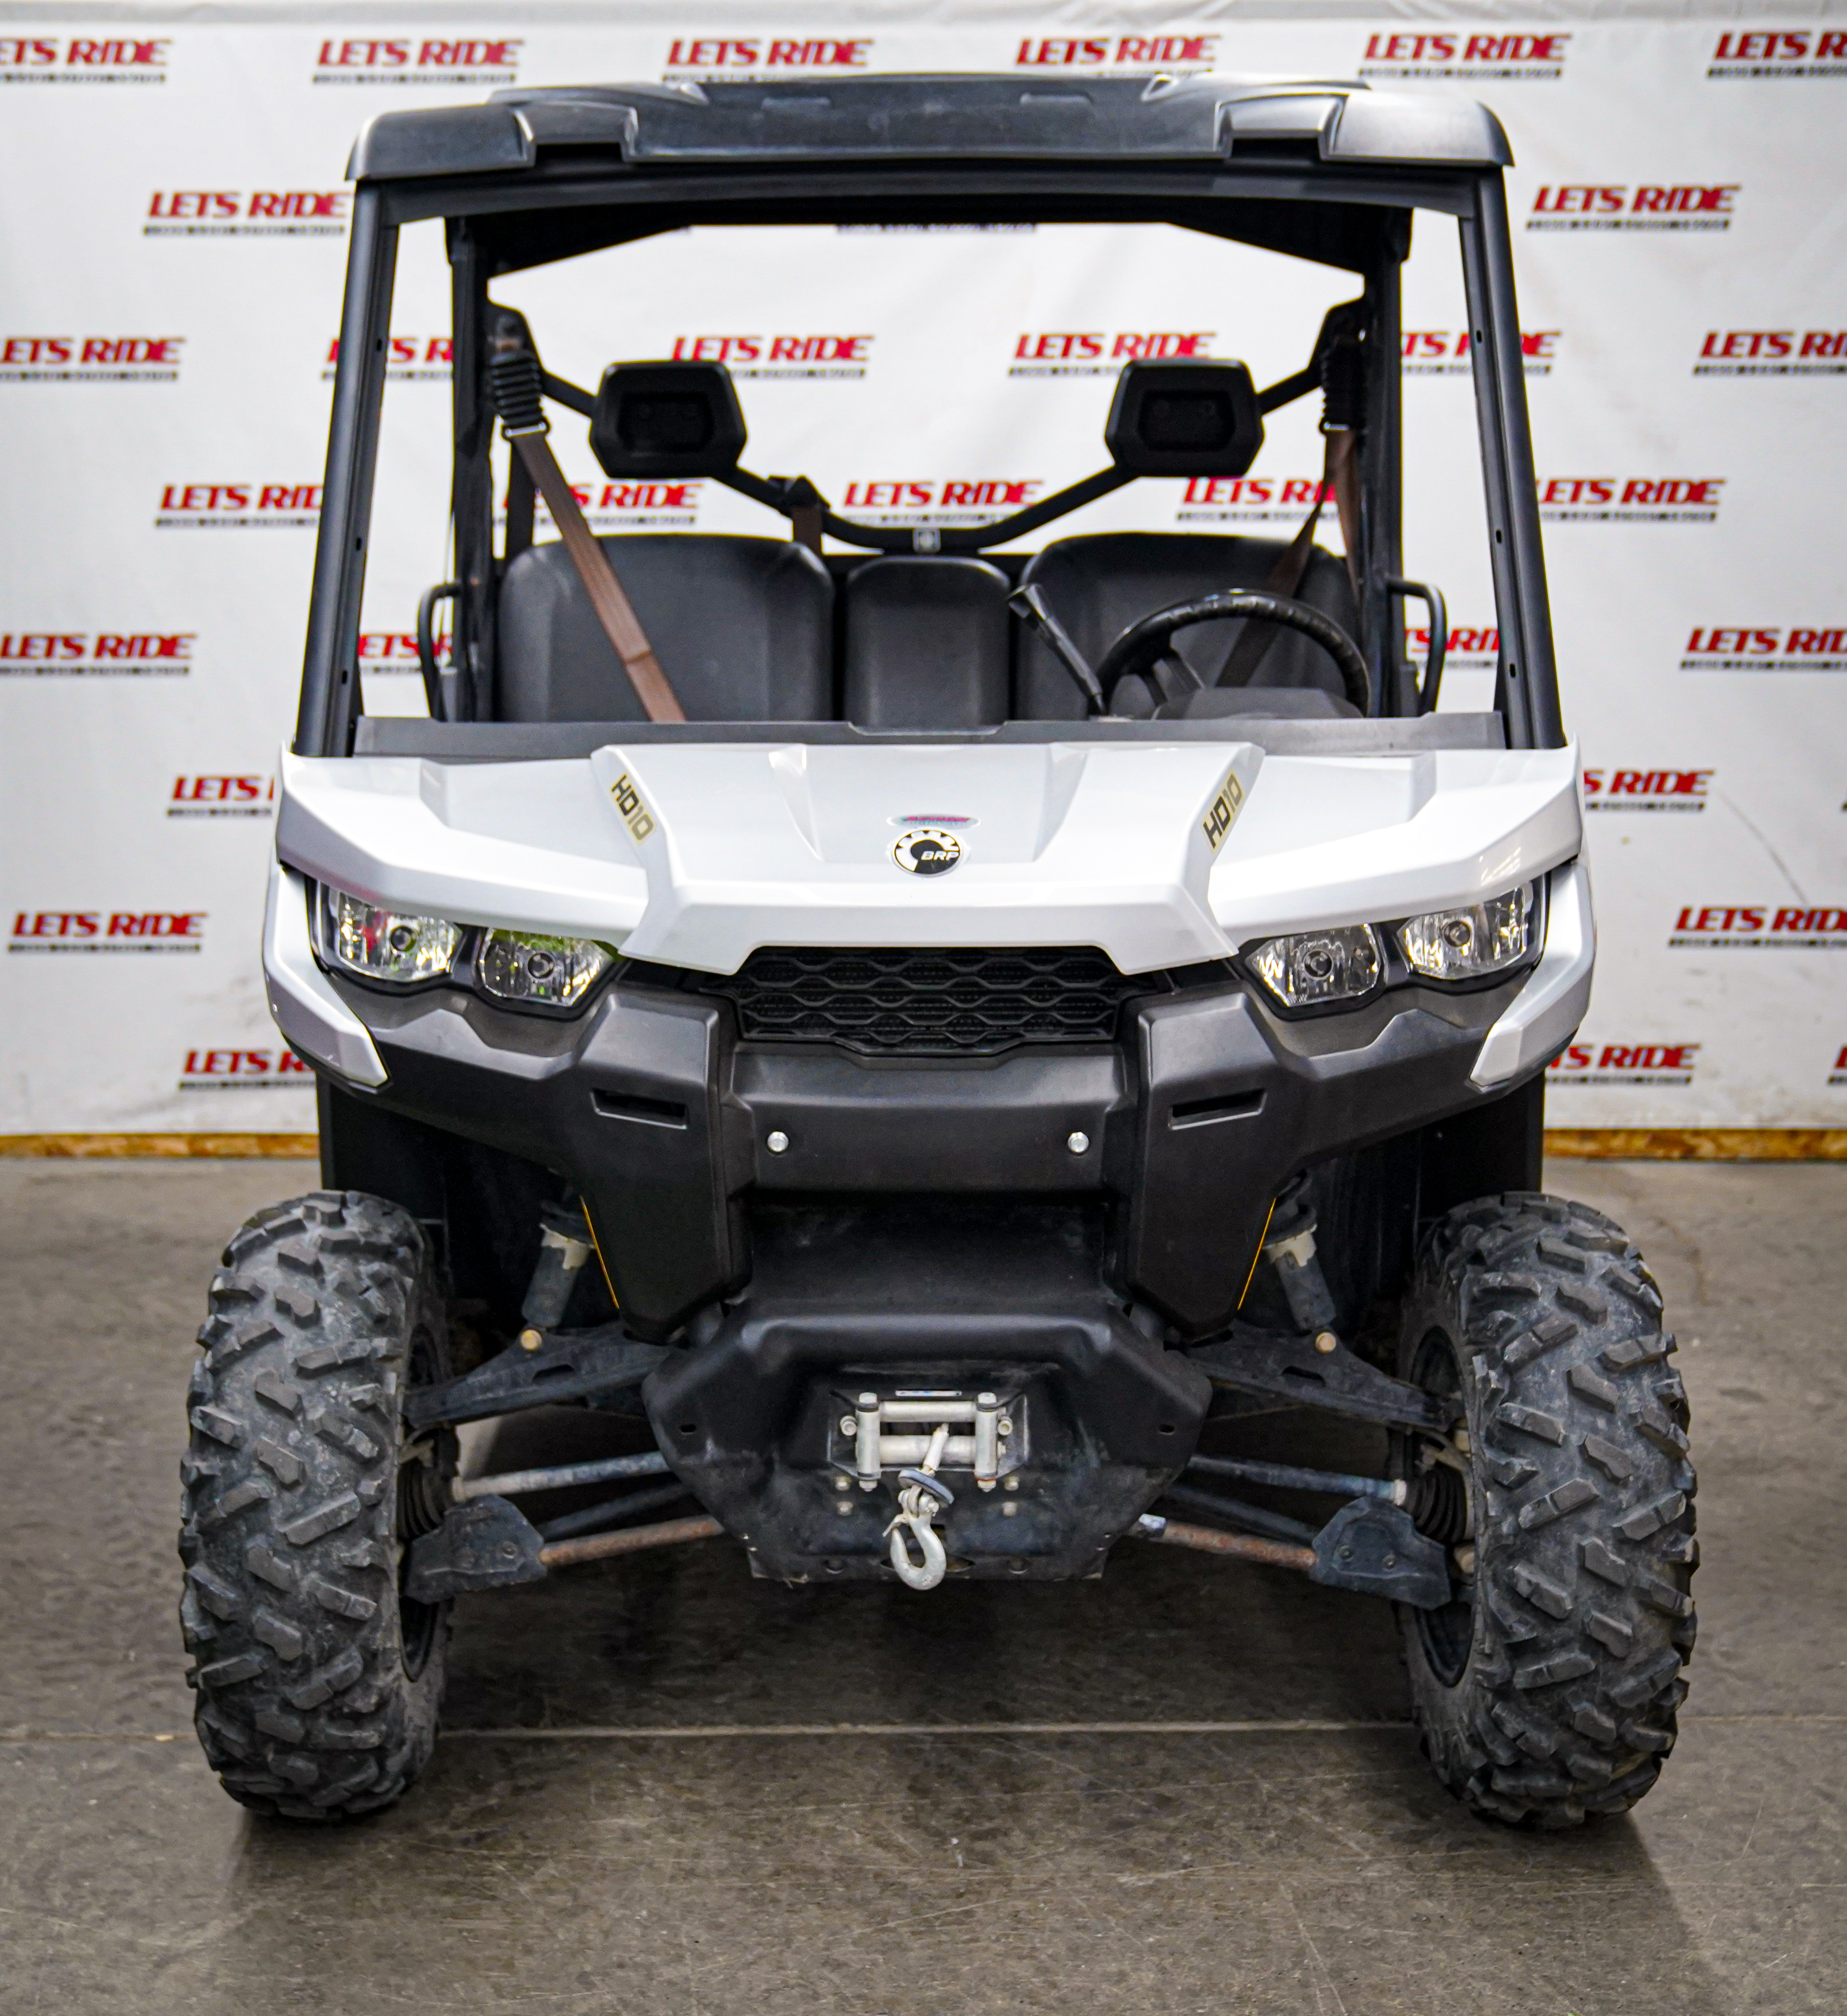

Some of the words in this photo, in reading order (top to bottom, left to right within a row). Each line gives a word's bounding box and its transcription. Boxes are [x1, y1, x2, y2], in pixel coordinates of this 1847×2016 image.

[67, 40, 171, 65] RIDE
[319, 40, 410, 66] LETS
[418, 40, 523, 66] RIDE
[668, 40, 760, 66] LETS
[767, 40, 873, 66] RIDE
[1015, 39, 1110, 65] LETS
[1115, 37, 1220, 62] RIDE
[1364, 34, 1457, 60] LETS
[1463, 34, 1571, 61] RIDE
[1714, 32, 1811, 60] LETS
[149, 193, 241, 218] LETS
[248, 193, 353, 217] RIDE
[1533, 186, 1627, 212] LETS
[1631, 185, 1741, 213] RIDE
[0, 338, 73, 364] ETS
[80, 338, 185, 364] RIDE
[670, 337, 761, 361] LETS
[769, 336, 874, 361] RIDE
[1015, 334, 1105, 359] LETS
[1111, 334, 1216, 360] RIDE
[1700, 332, 1795, 359] LETS
[160, 485, 250, 510] LETS
[257, 485, 325, 511] RID
[599, 483, 704, 508] RIDE
[844, 482, 933, 507] LETS
[940, 481, 1043, 508] RIDE
[1183, 477, 1273, 503] LETS
[1535, 479, 1616, 505] ETS
[1619, 479, 1725, 505] RIDE
[1, 634, 86, 660] LETS
[93, 634, 197, 660] RIDE
[357, 634, 420, 658] ETS
[1687, 628, 1780, 655] LETS
[172, 776, 261, 801] LETS
[1609, 770, 1715, 795] RIDE
[611, 773, 655, 841] HD10
[1202, 773, 1242, 850] HD10
[921, 850, 959, 861] BRP
[13, 913, 100, 937] LETS
[106, 913, 208, 937] RIDE
[1675, 907, 1767, 932] LETS
[1772, 907, 1847, 932] RID
[183, 1050, 271, 1074] LETS
[1597, 1044, 1701, 1069] RIDE
